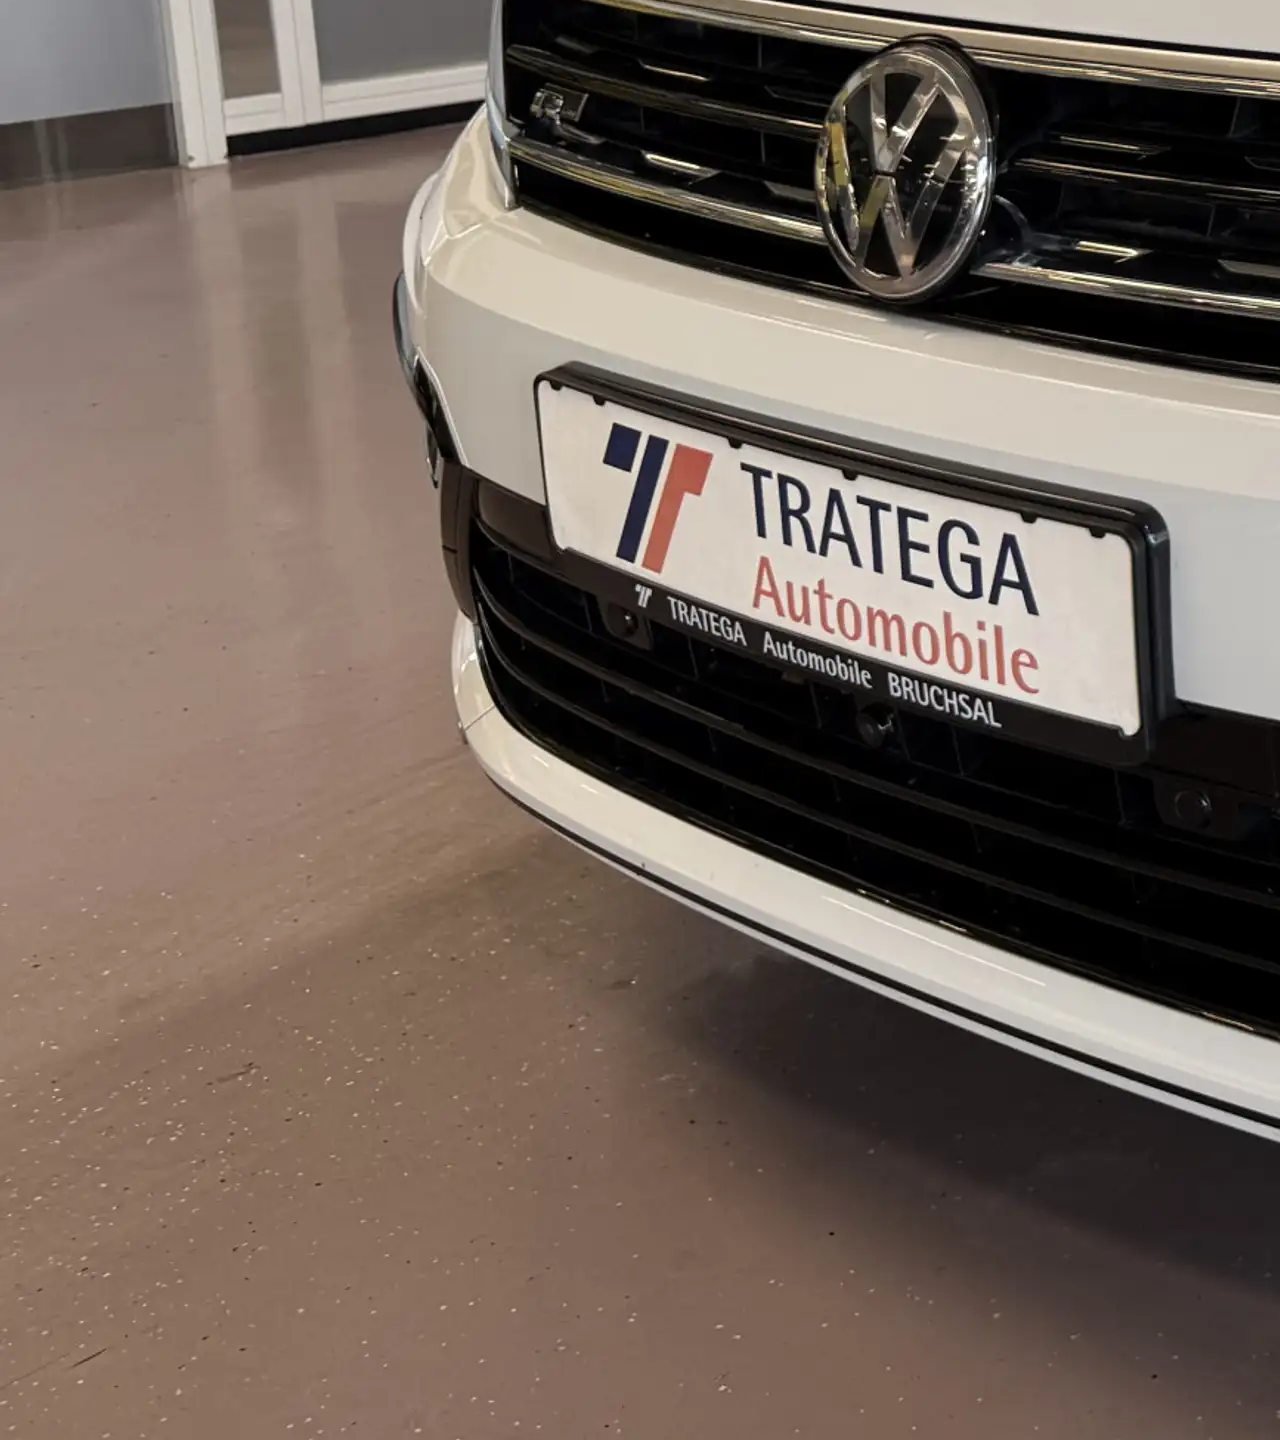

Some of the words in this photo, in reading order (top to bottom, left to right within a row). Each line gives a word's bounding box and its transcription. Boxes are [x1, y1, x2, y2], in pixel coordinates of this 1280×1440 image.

[740, 461, 1040, 617] TRATEGA
[666, 595, 748, 647] TRATEGA
[762, 630, 873, 690] Automobile
[887, 671, 1003, 729] BRUCHSAL
[752, 554, 1041, 694] Automobile
